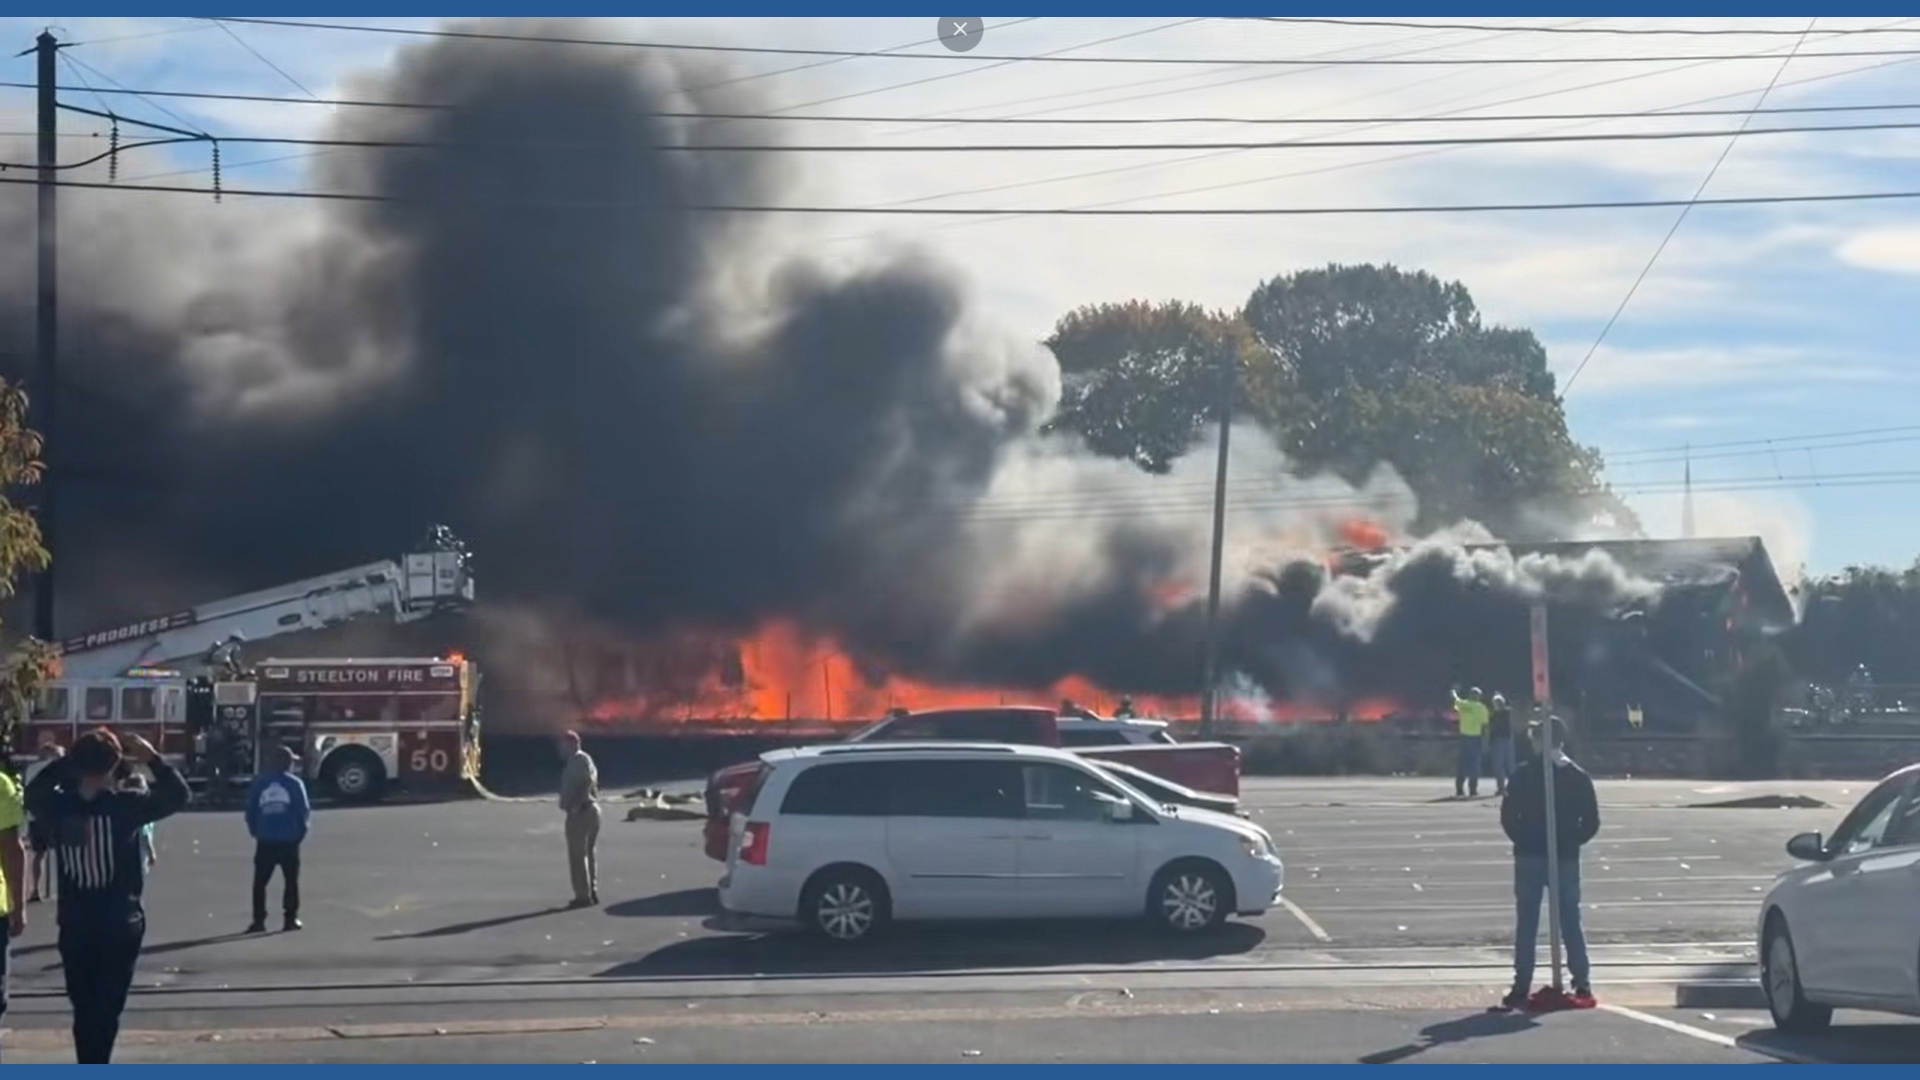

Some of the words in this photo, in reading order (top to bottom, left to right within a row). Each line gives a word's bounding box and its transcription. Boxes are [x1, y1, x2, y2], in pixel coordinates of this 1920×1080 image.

[86, 616, 169, 647] PROGRESS
[297, 669, 379, 683] STEELTON
[387, 669, 423, 682] FIRE
[411, 749, 448, 771] 50
